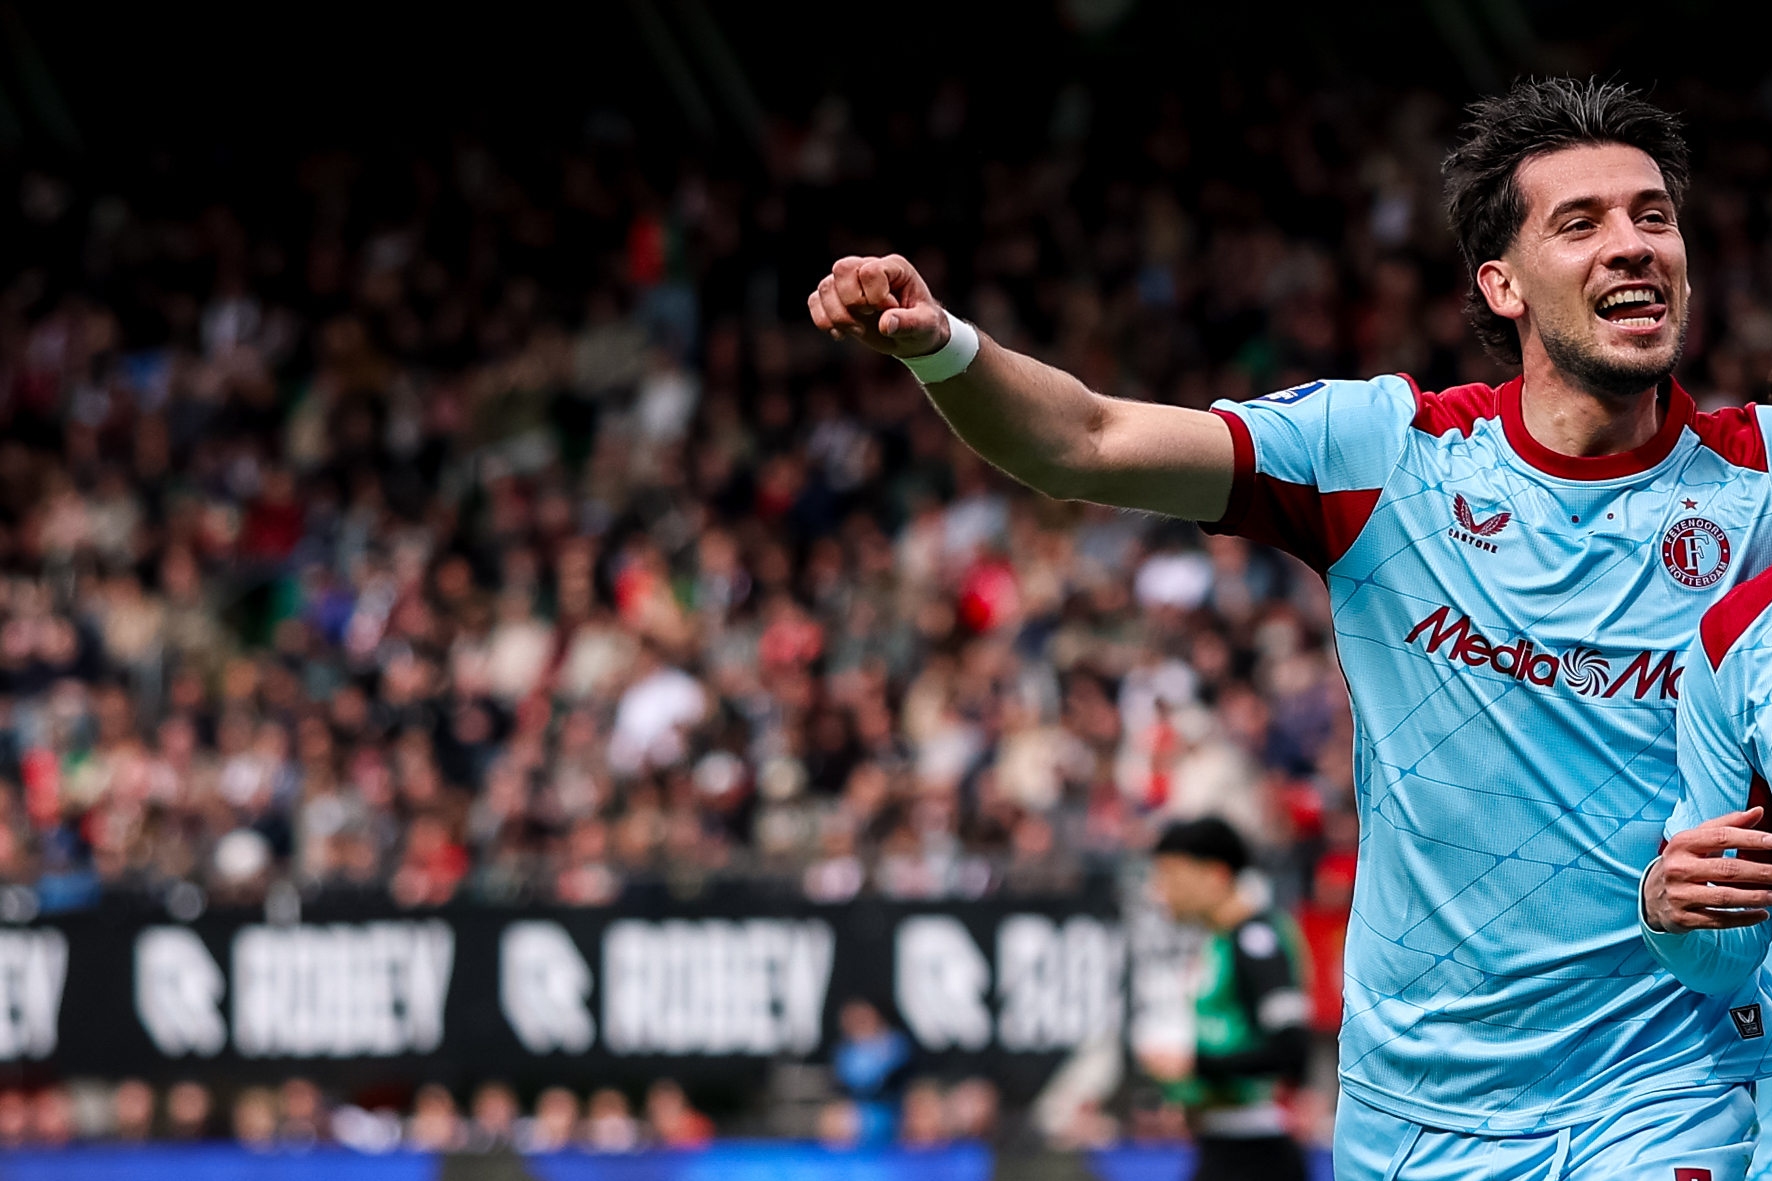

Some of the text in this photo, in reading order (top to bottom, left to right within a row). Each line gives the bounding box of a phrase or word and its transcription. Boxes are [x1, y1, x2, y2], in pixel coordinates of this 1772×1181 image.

[1448, 528, 1498, 554] CASTORE
[1664, 518, 1725, 544] FEYENOORD
[1681, 534, 1710, 571] F
[1667, 561, 1728, 587] ROTTERDAM
[1404, 605, 1560, 688] Media
